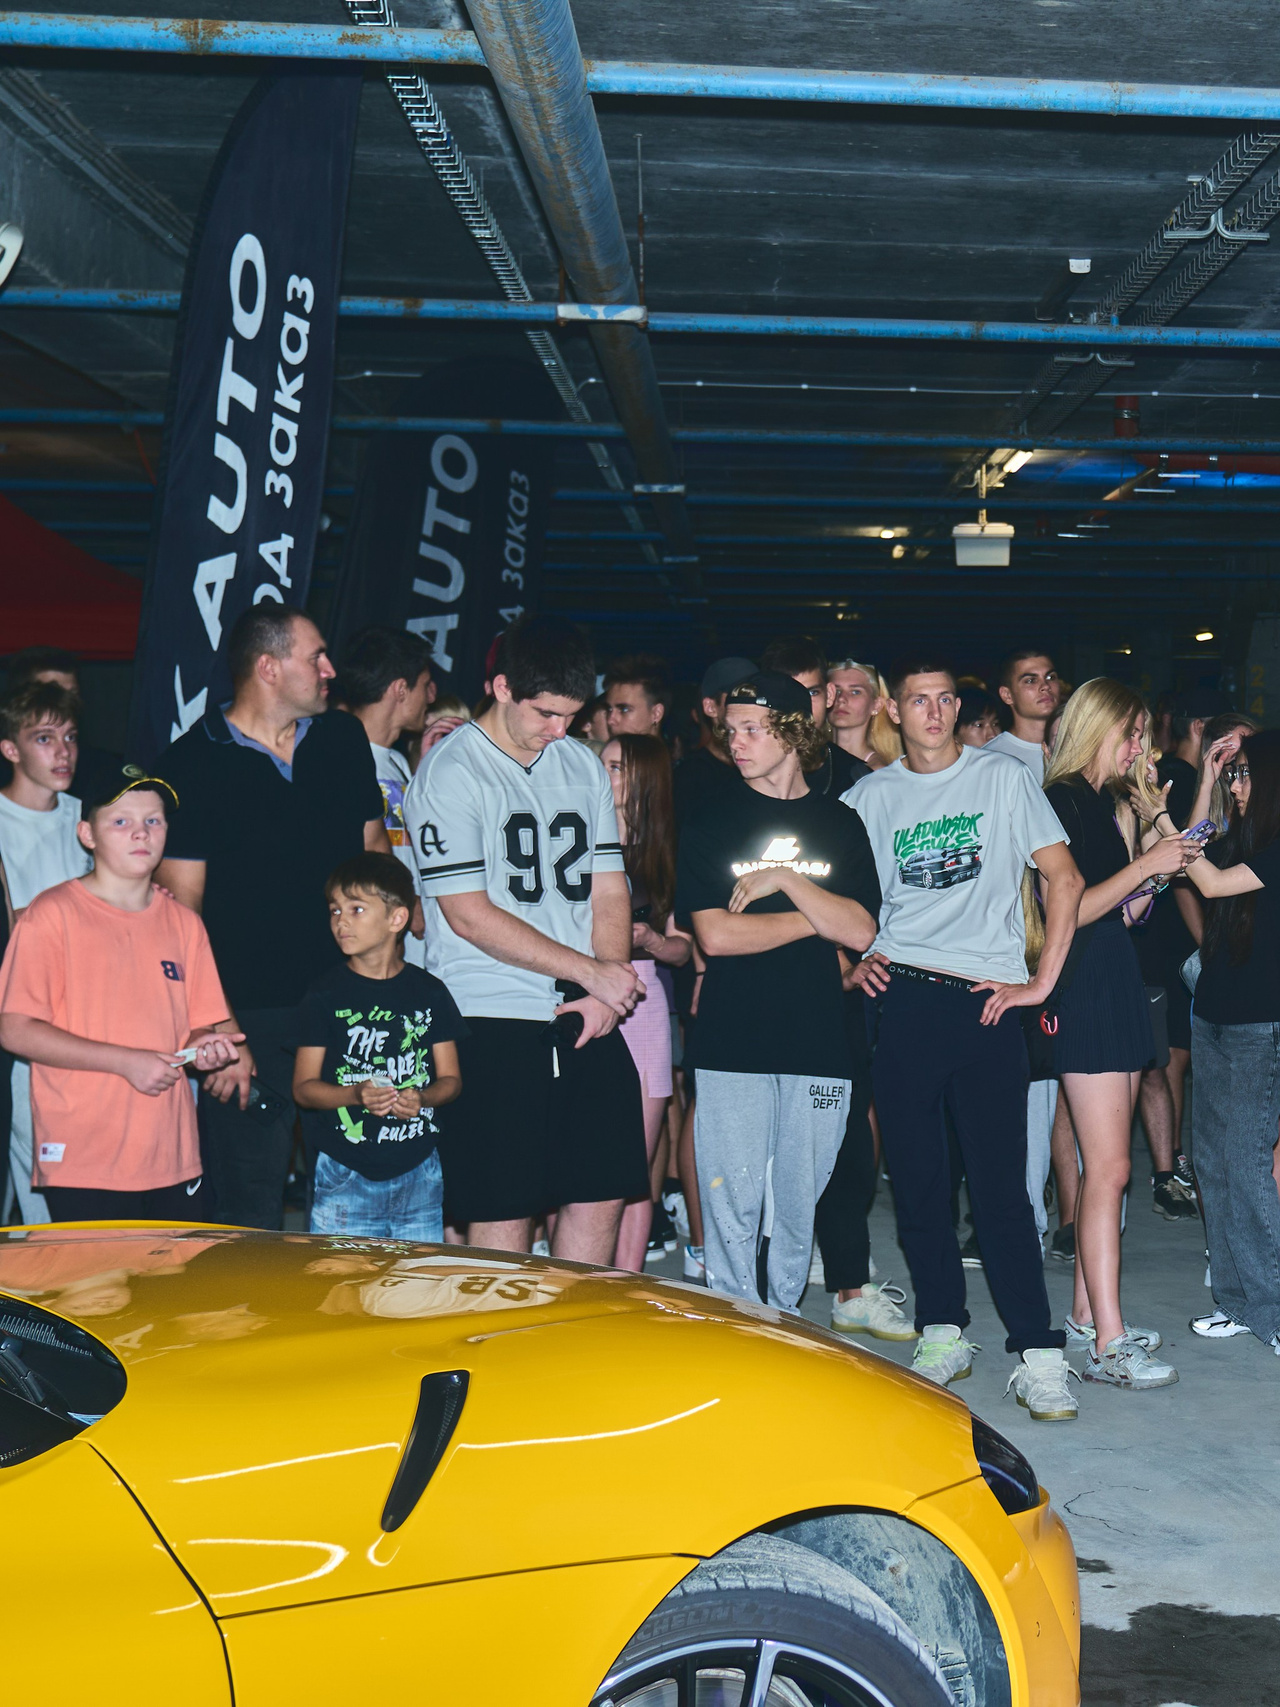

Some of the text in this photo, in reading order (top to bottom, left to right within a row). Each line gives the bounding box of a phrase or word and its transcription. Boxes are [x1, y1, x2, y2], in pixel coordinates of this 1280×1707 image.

[193, 233, 267, 651] AUTO
[264, 274, 314, 509] заказ
[406, 434, 478, 673] AUTO
[501, 470, 530, 589] заказ
[500, 810, 592, 906] 92
[347, 1025, 390, 1061] THE
[813, 1098, 841, 1110] DEPT.
